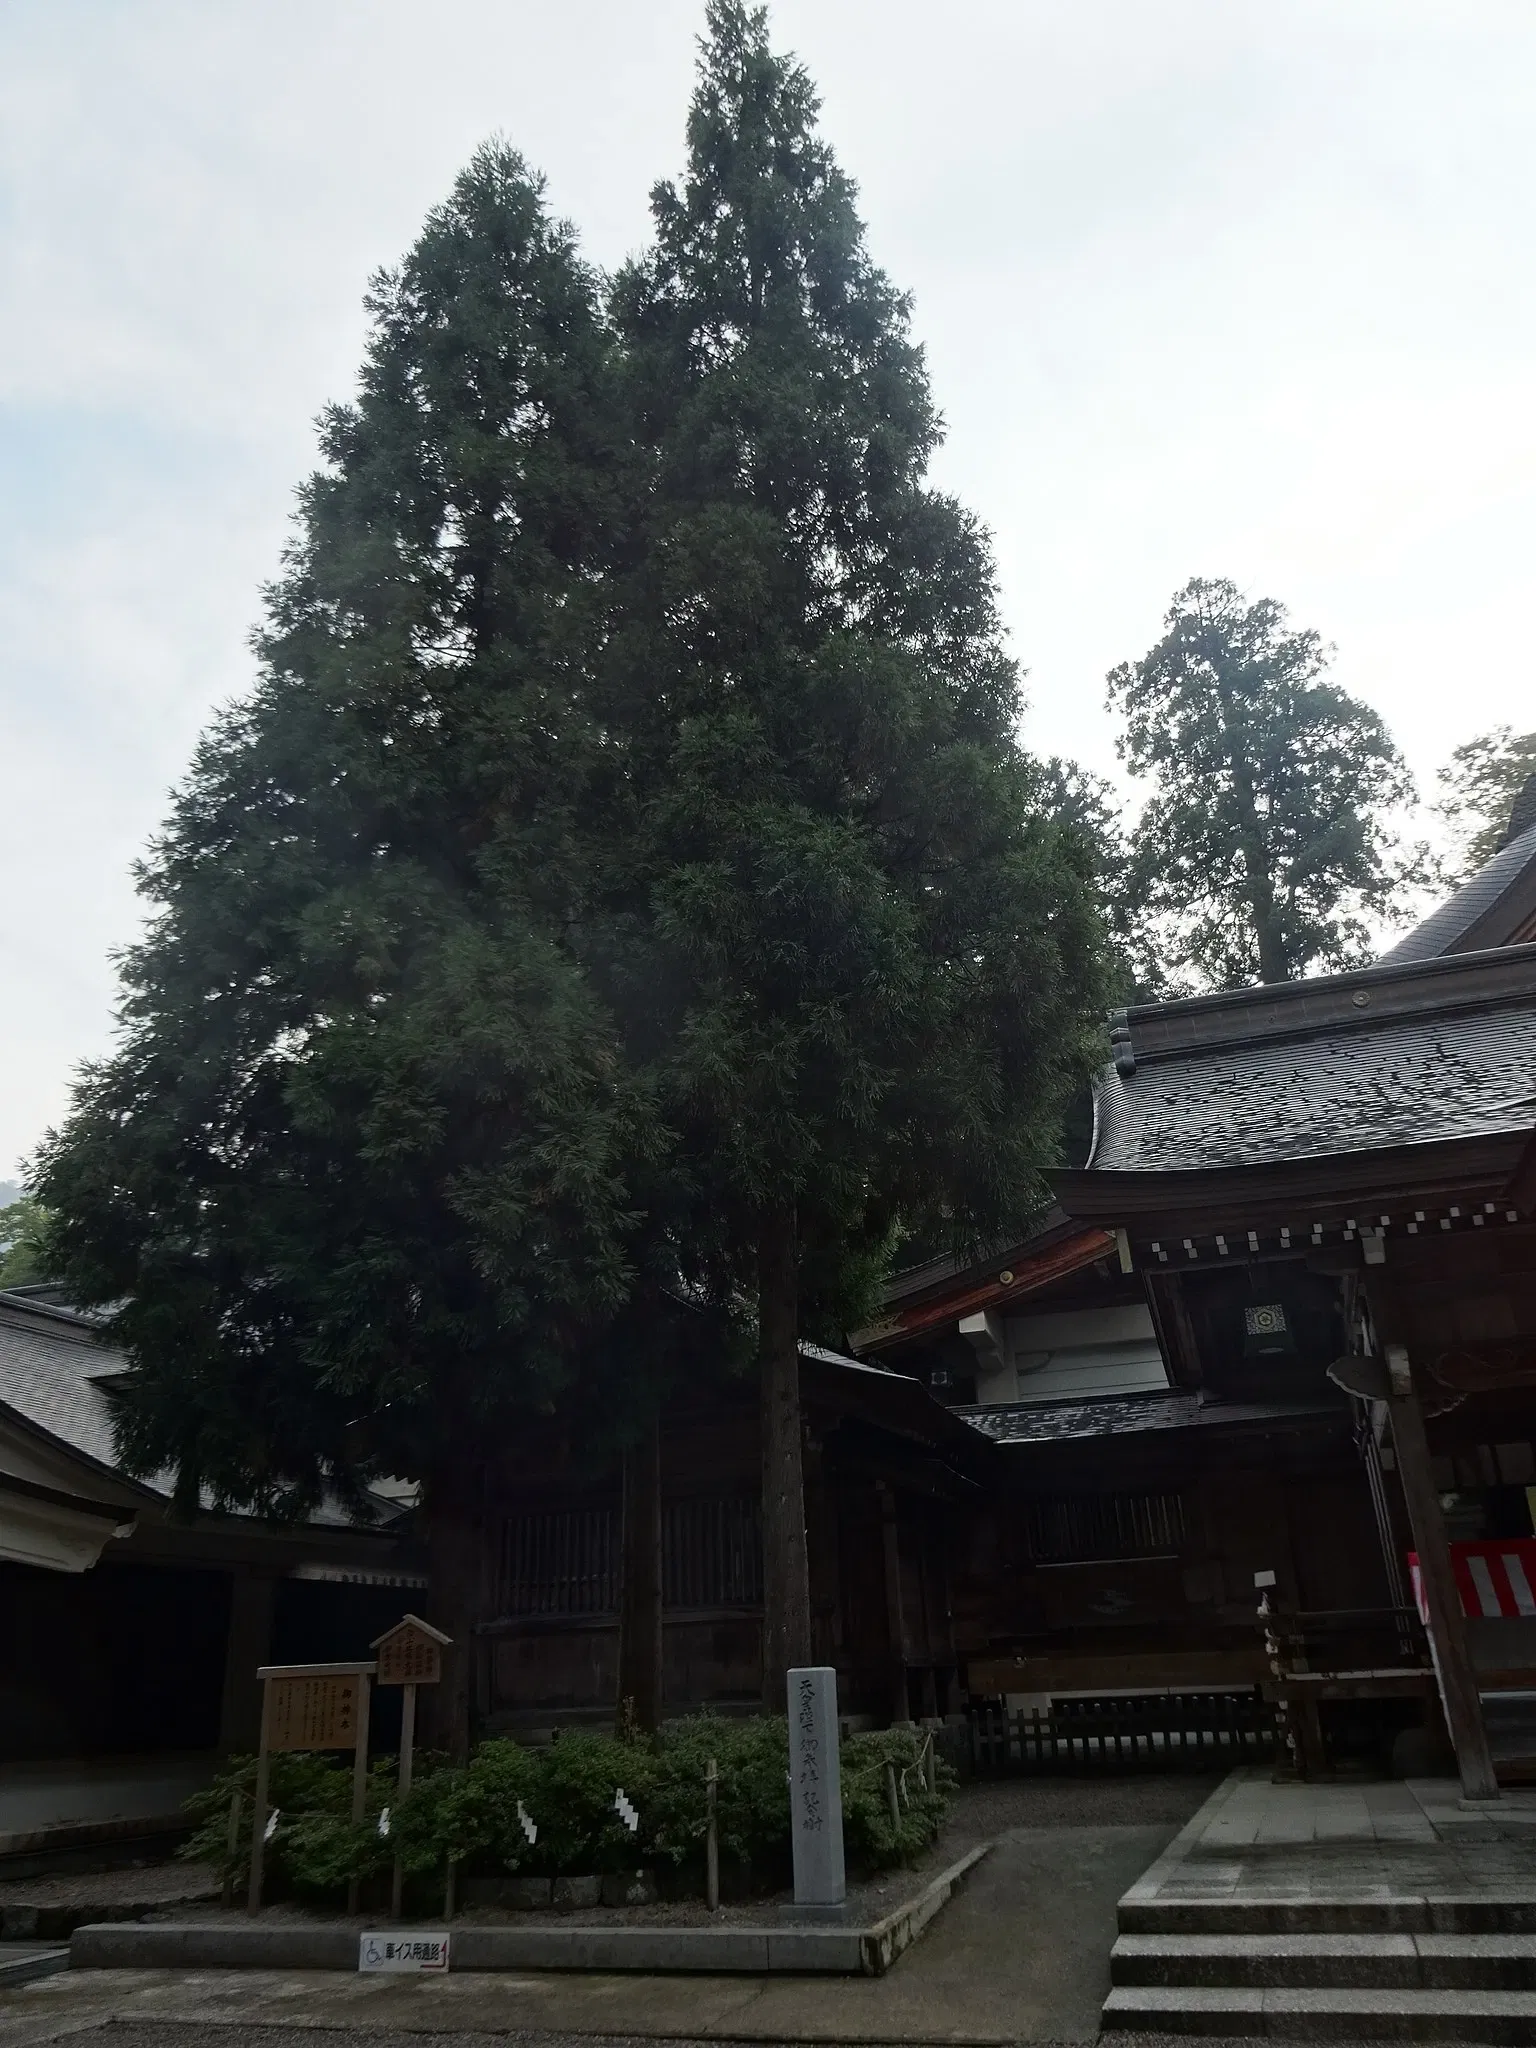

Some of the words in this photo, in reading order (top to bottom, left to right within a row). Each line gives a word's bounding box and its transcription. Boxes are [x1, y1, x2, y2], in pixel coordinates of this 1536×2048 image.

[386, 1943, 440, 1961] 車イス用通路
